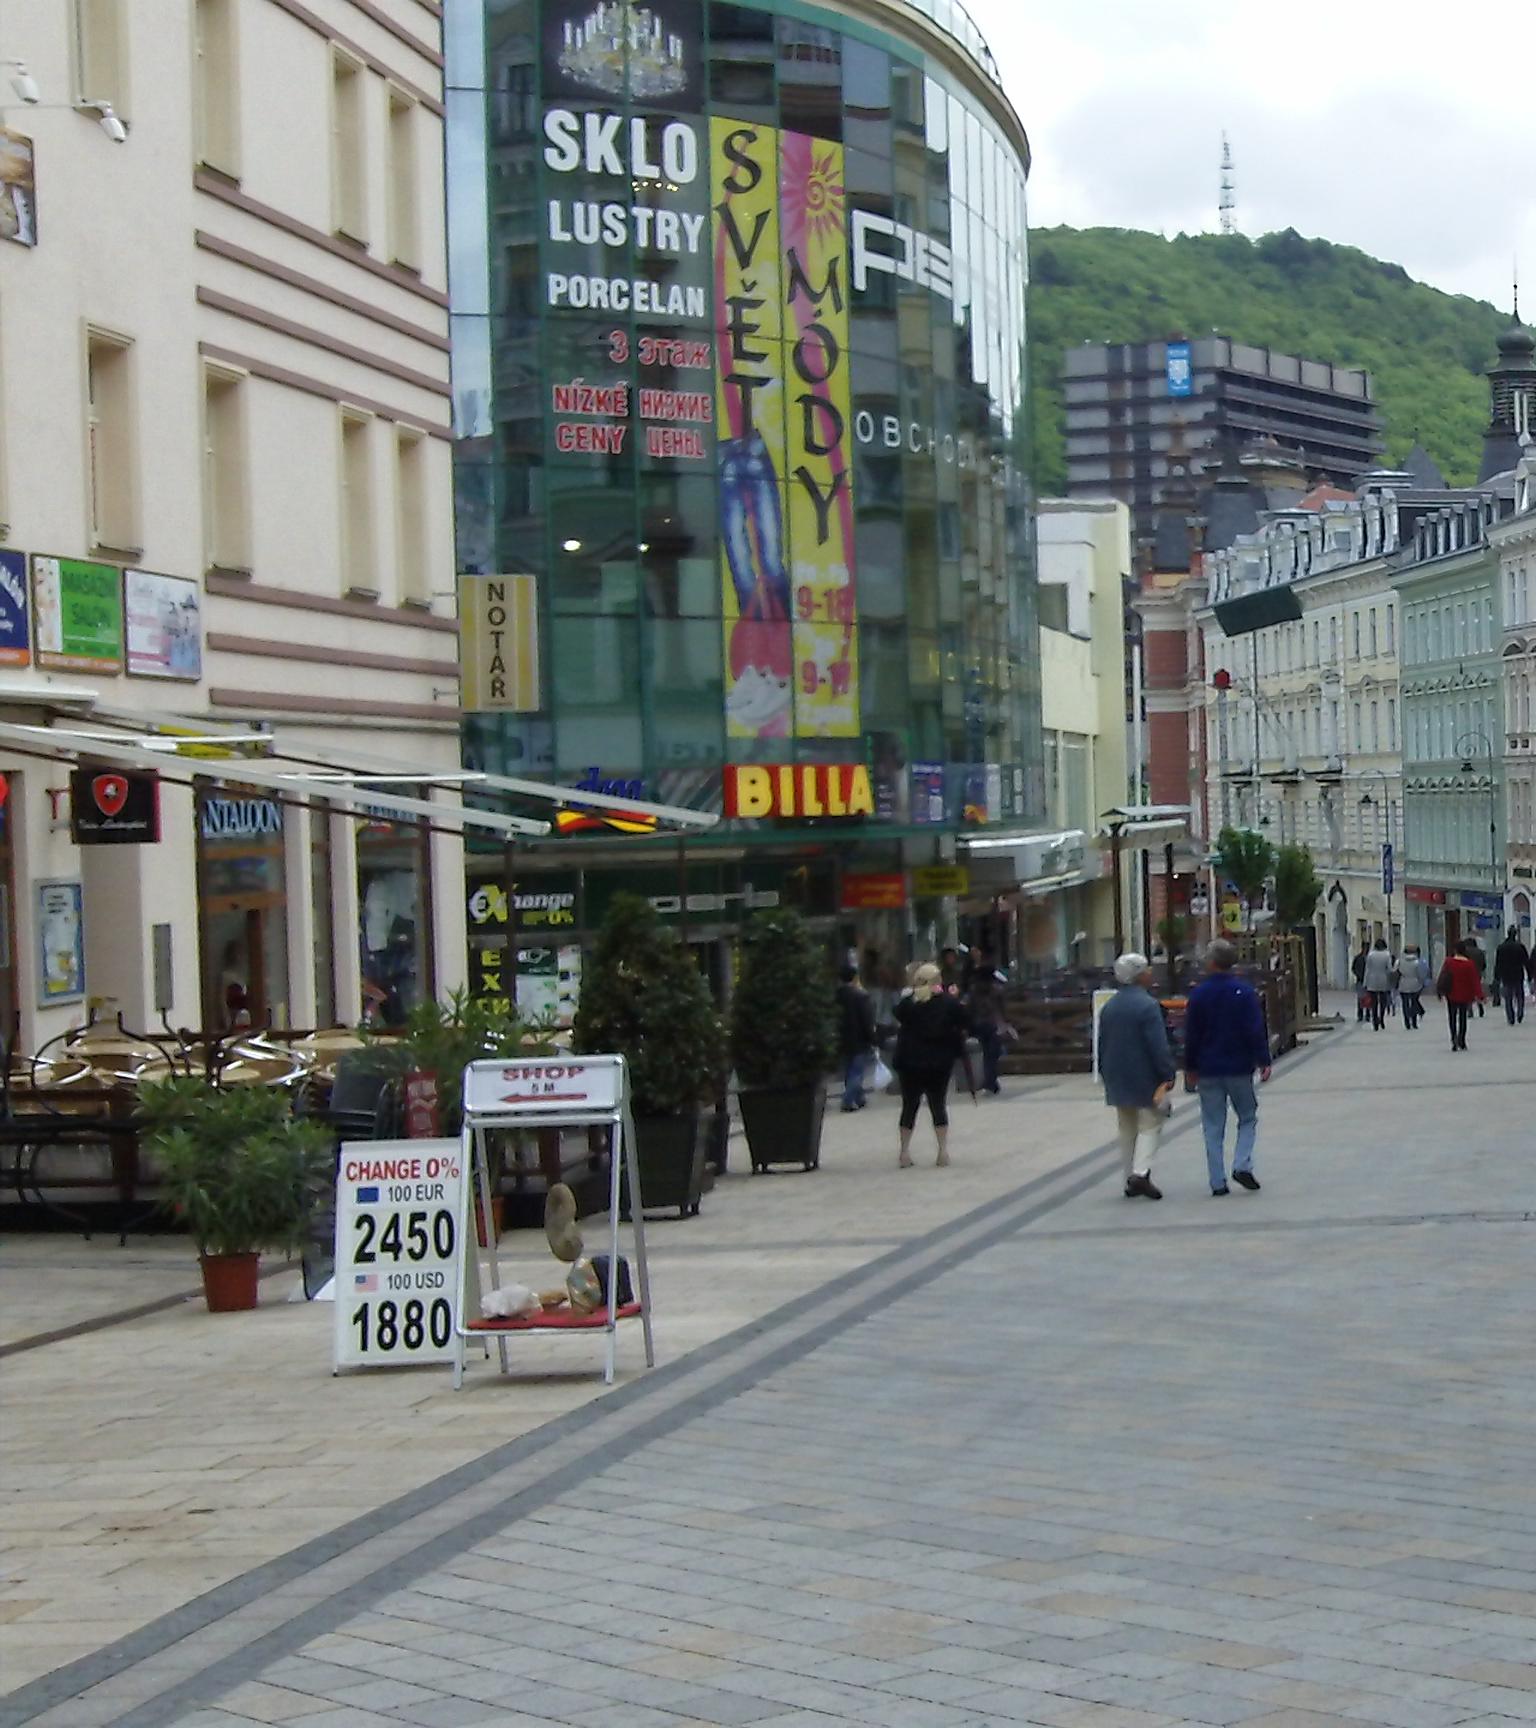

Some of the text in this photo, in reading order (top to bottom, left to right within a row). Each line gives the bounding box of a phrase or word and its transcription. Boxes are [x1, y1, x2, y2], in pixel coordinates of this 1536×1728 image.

[544, 109, 697, 183] SKLO
[549, 200, 705, 253] LUSTRY
[548, 273, 705, 317] PORCELAN
[714, 128, 775, 440] SVĚT
[609, 330, 629, 363] 3
[553, 377, 629, 417] NÍZKÉ
[638, 388, 712, 424] НИЗКИЕ
[556, 422, 627, 455] CENY
[647, 426, 706, 459] ЦЕНЫ
[487, 582, 506, 698] NOTAR
[737, 765, 875, 817] BILLA
[503, 1066, 585, 1081] SHOP
[346, 1156, 460, 1181] CHANGE 0%
[387, 1184, 444, 1202] 100 EUR
[354, 1209, 455, 1265] 2450
[387, 1272, 444, 1290] 100 USD
[352, 1298, 452, 1352] 1880
